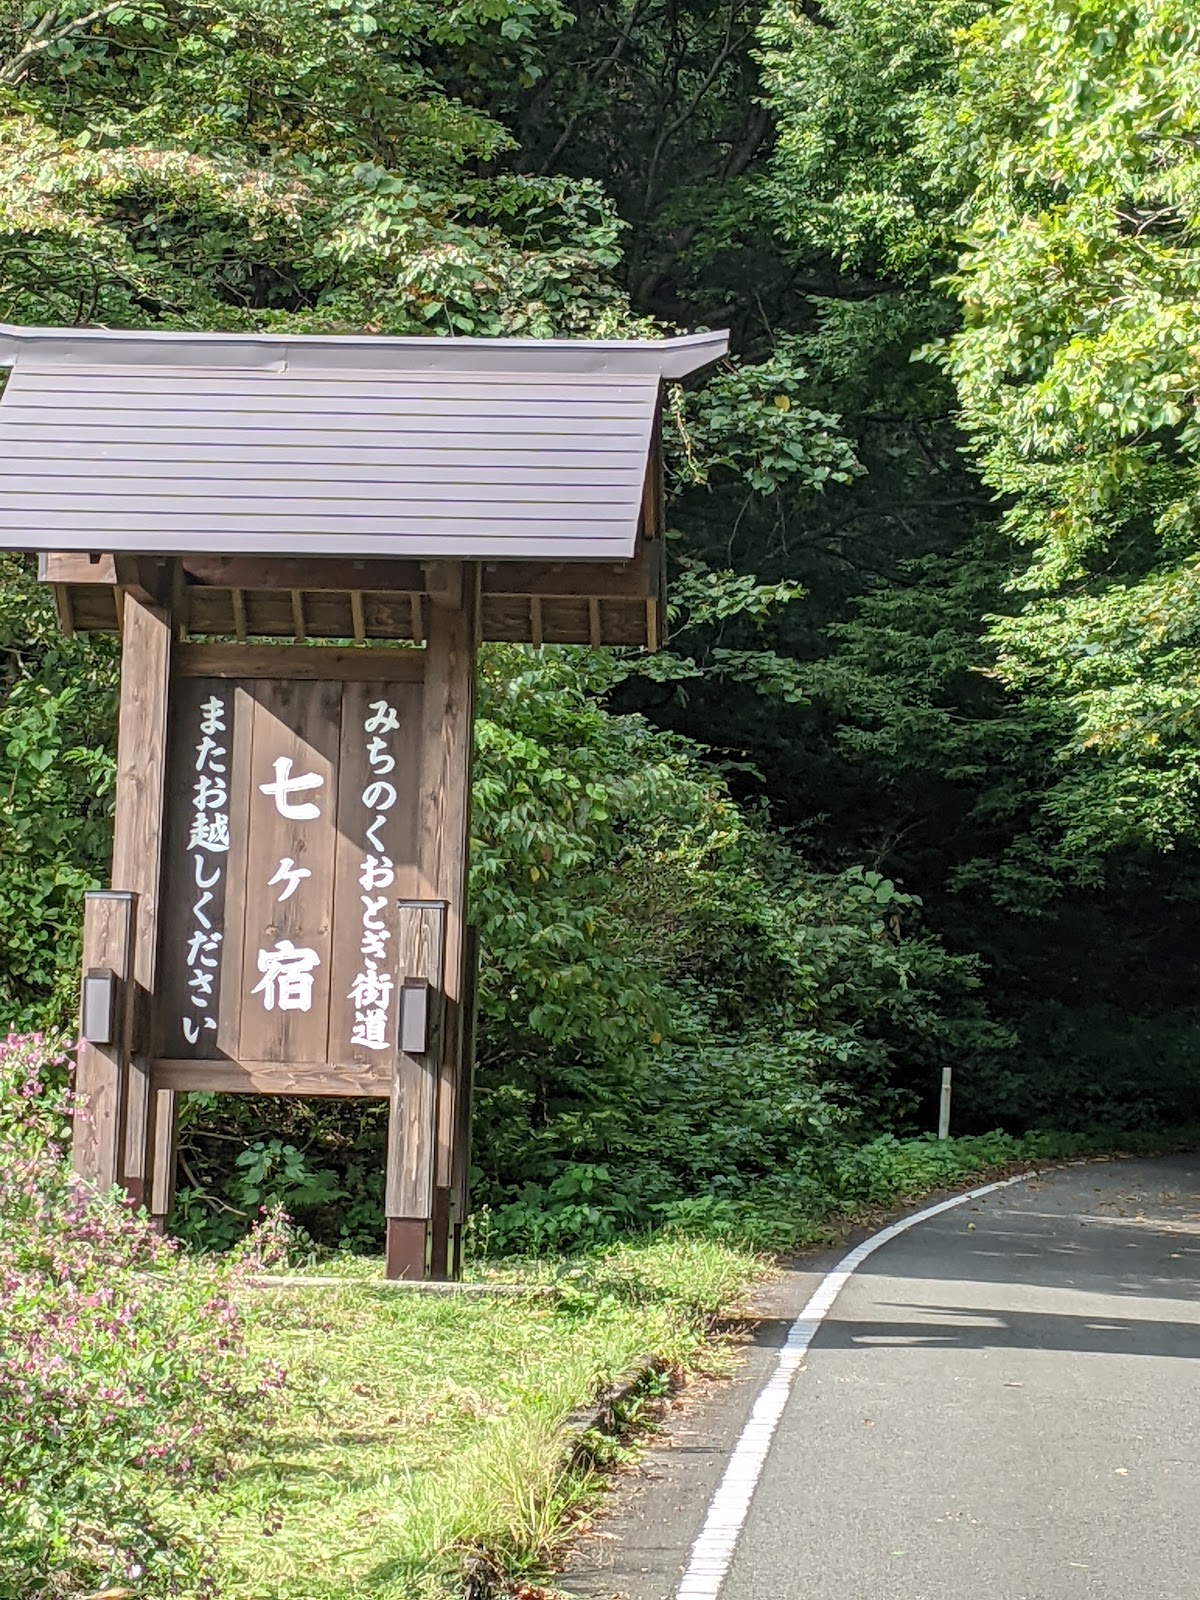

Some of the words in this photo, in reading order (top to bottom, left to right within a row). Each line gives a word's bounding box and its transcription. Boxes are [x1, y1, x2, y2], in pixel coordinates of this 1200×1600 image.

[182, 695, 231, 1044] またお越しください
[346, 700, 400, 1050] みちのくおとぎ街道
